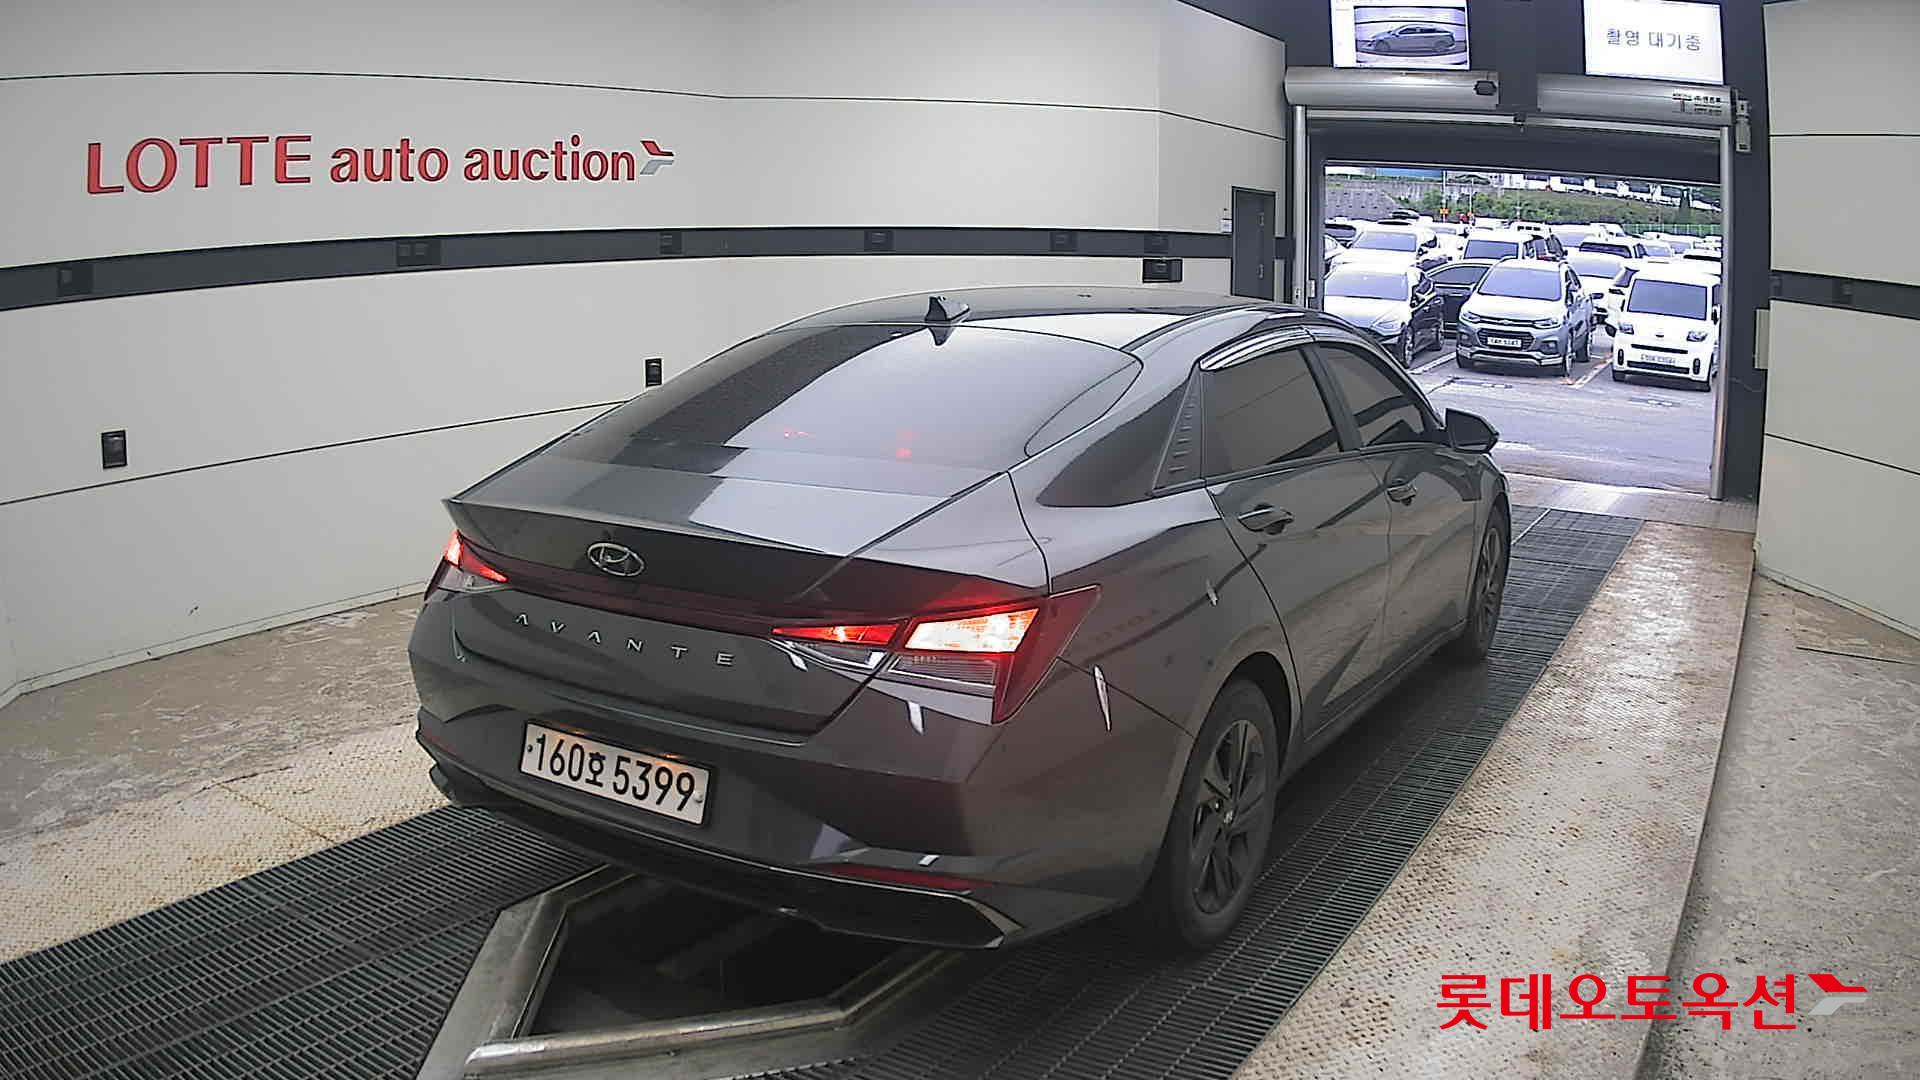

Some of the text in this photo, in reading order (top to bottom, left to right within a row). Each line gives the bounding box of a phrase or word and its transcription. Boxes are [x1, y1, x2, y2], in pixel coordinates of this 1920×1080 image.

[1606, 28, 1702, 52] 촬영 대기중
[86, 133, 636, 196] LOTTE auto auction
[515, 613, 736, 667] AVANTE
[535, 733, 696, 813] 160호 5399
